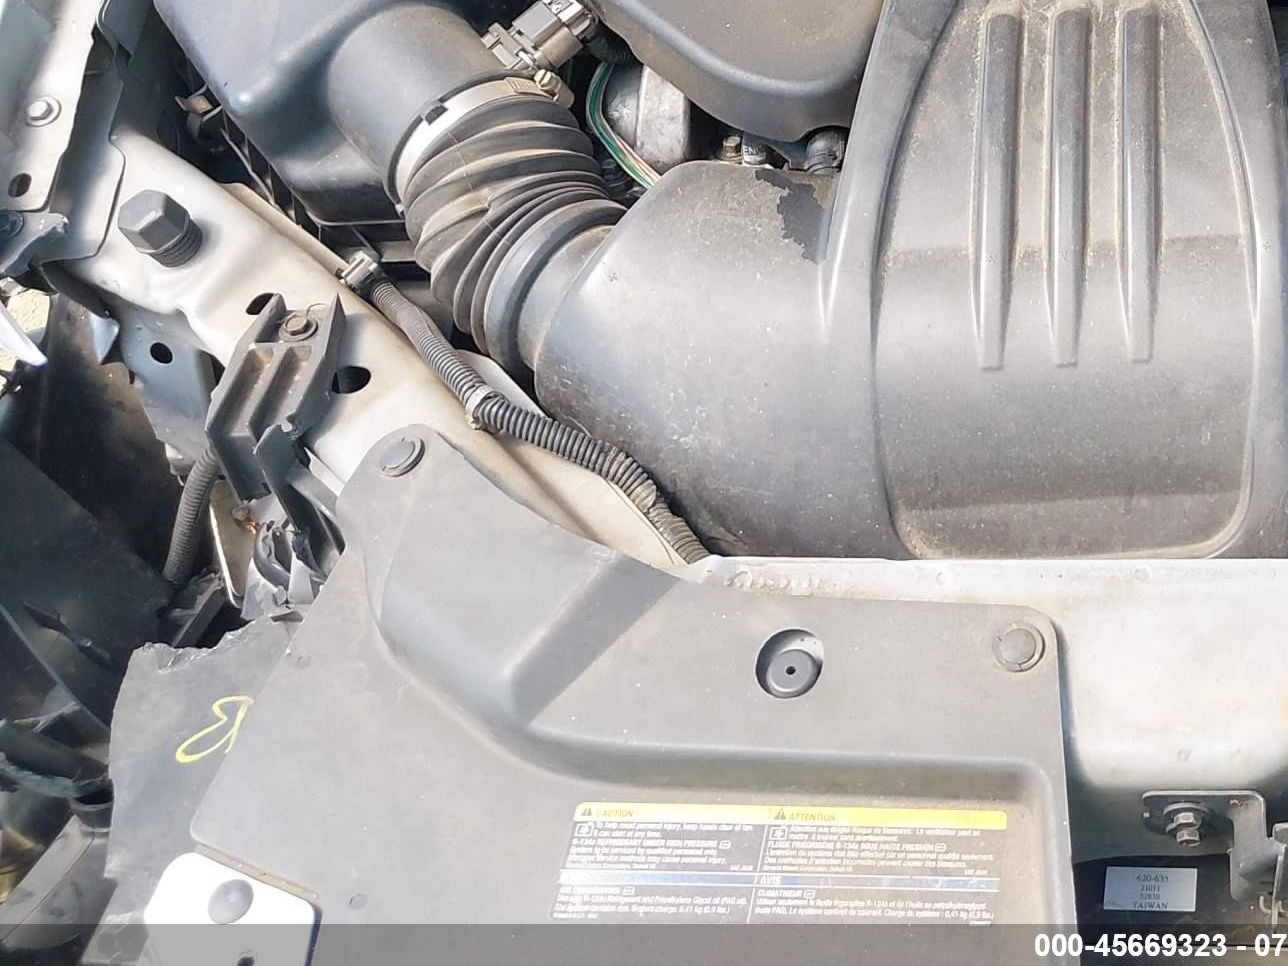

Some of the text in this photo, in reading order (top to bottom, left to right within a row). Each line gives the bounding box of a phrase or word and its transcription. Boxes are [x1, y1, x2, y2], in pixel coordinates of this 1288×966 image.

[596, 810, 634, 818] CAUTION
[788, 812, 836, 822] ATTENTION
[760, 875, 782, 884] AVIS
[1134, 902, 1168, 910] TAIWAN
